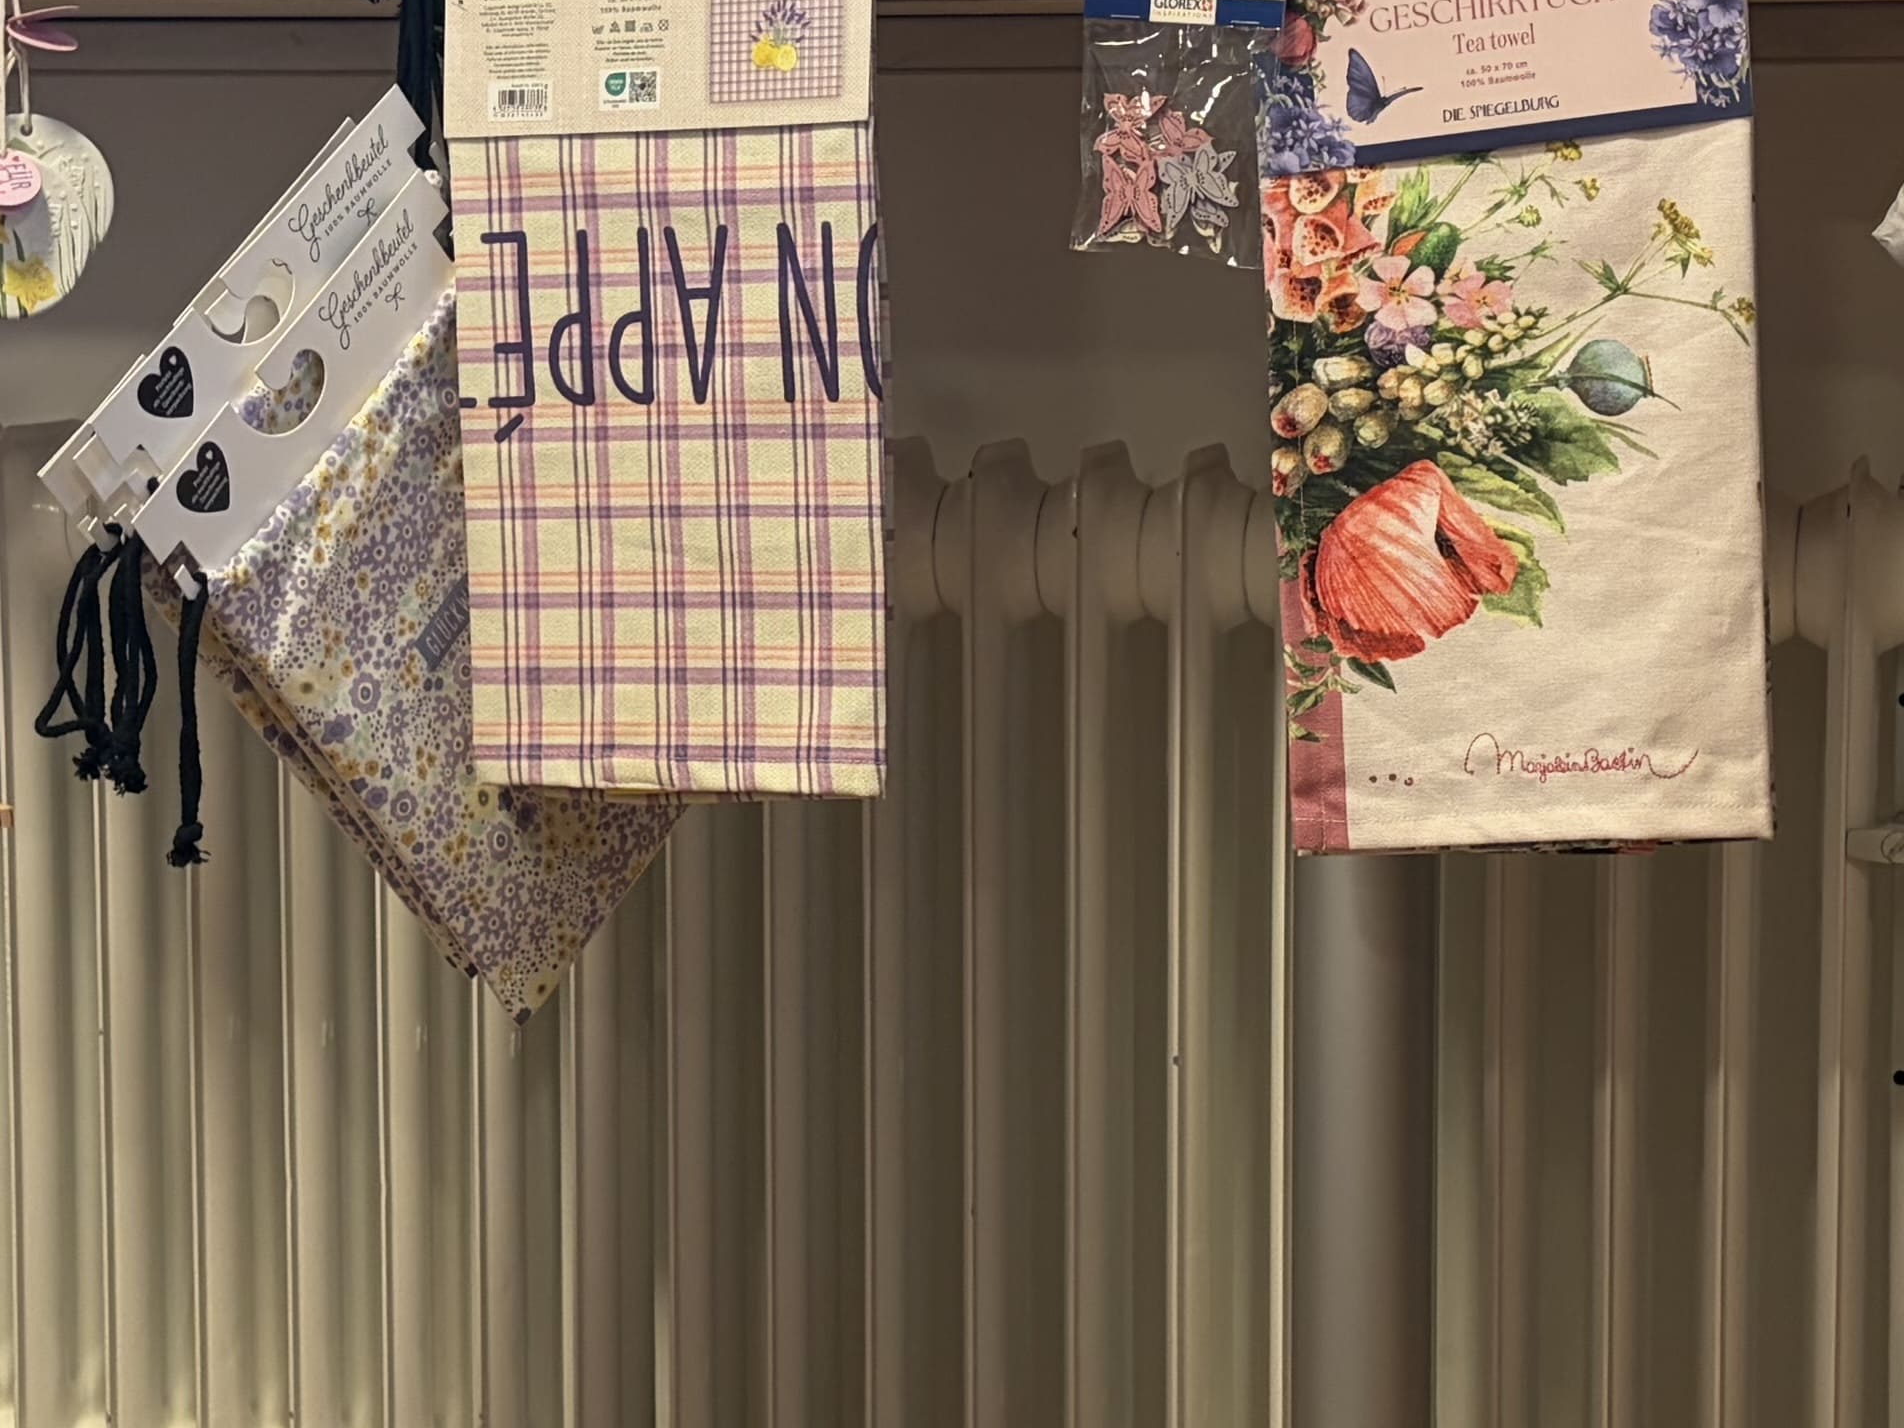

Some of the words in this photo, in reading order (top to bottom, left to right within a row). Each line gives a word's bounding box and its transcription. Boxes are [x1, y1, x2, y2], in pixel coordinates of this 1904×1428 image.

[1452, 31, 1486, 55] Tea
[1491, 22, 1537, 51] towel
[1442, 107, 1467, 124] DIE
[1469, 95, 1561, 120] SPIEGELBURG
[286, 123, 391, 262] Geschenkbeutel
[317, 207, 416, 351] Geschenkbeutel
[461, 224, 728, 444] APPÉ
